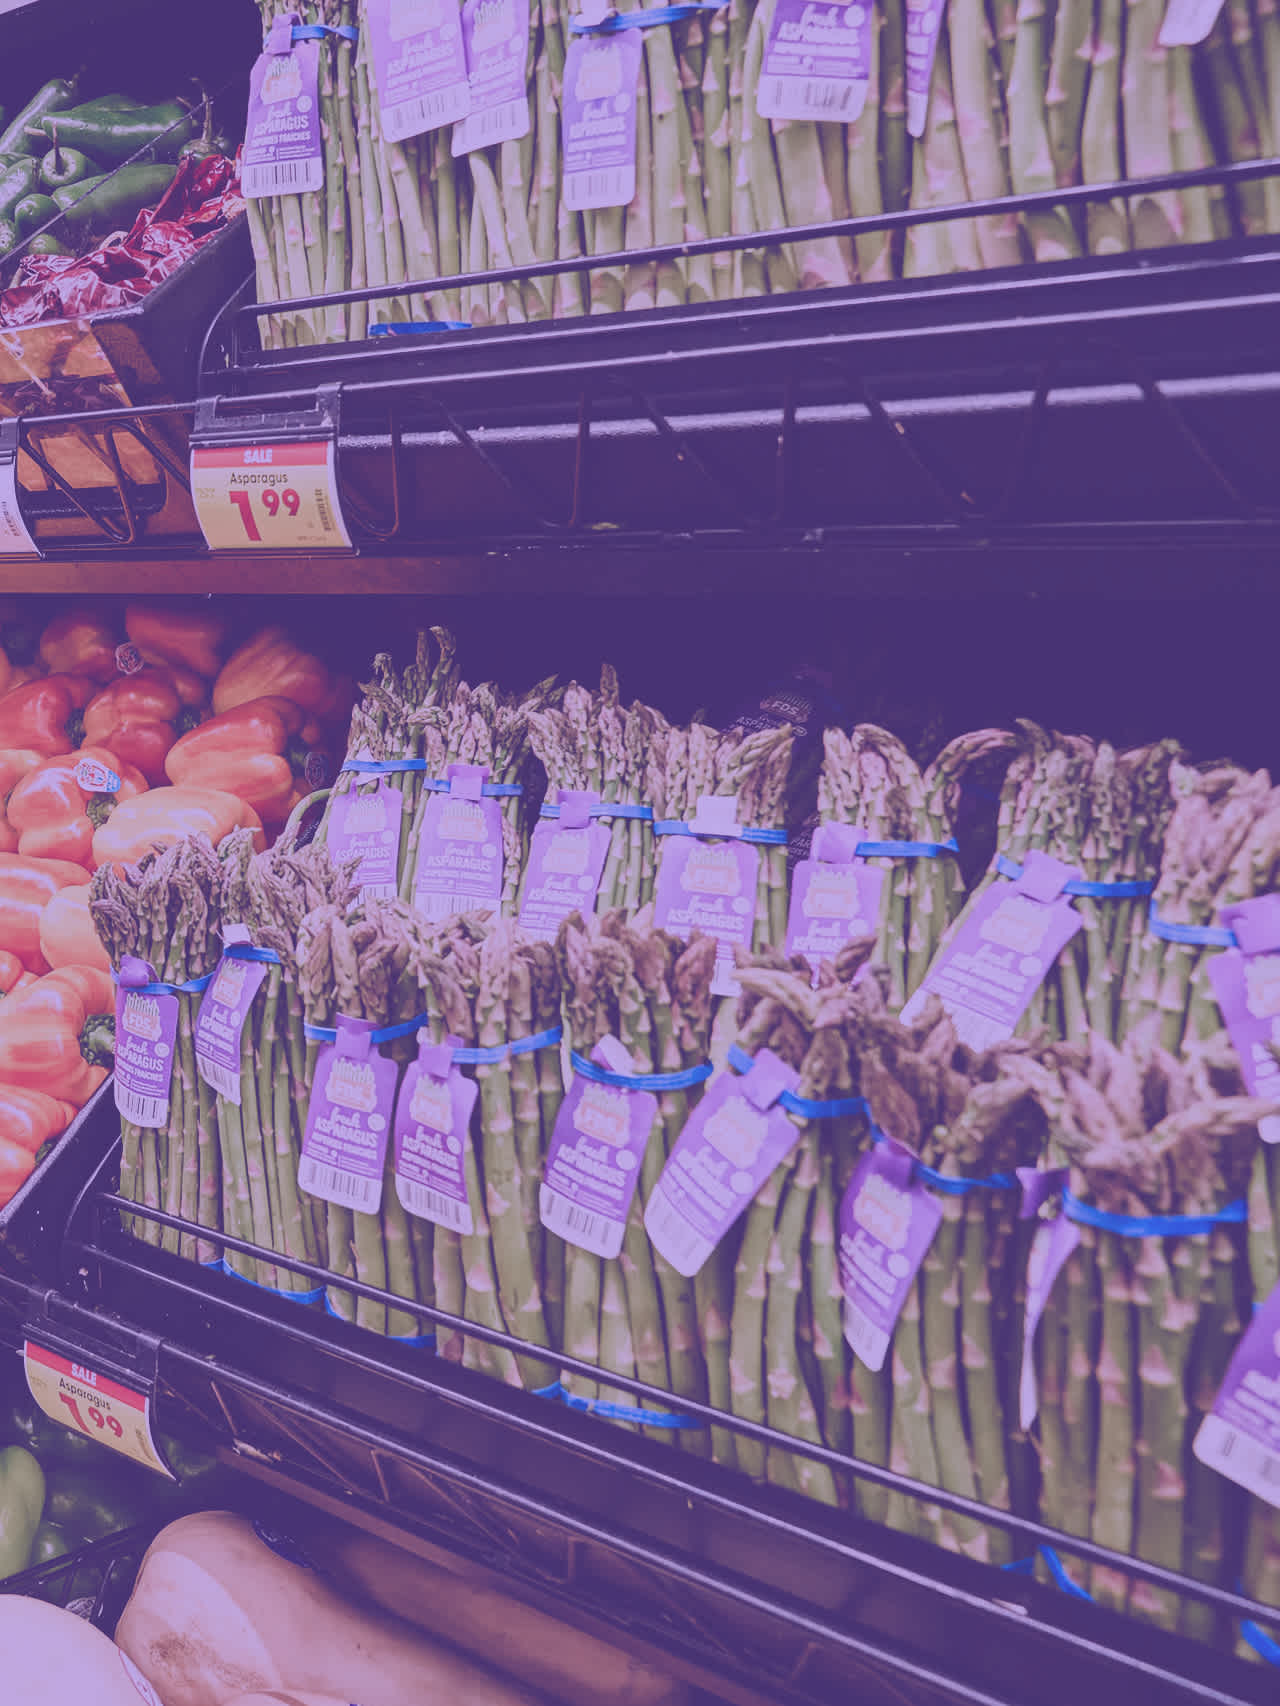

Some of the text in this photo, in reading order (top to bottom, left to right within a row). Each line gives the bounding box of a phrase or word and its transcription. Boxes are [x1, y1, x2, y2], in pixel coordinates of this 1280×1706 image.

[243, 448, 273, 464] SALE
[230, 472, 289, 487] Asparagus
[72, 1362, 97, 1387] SALE
[59, 1377, 111, 1411] Asparagus
